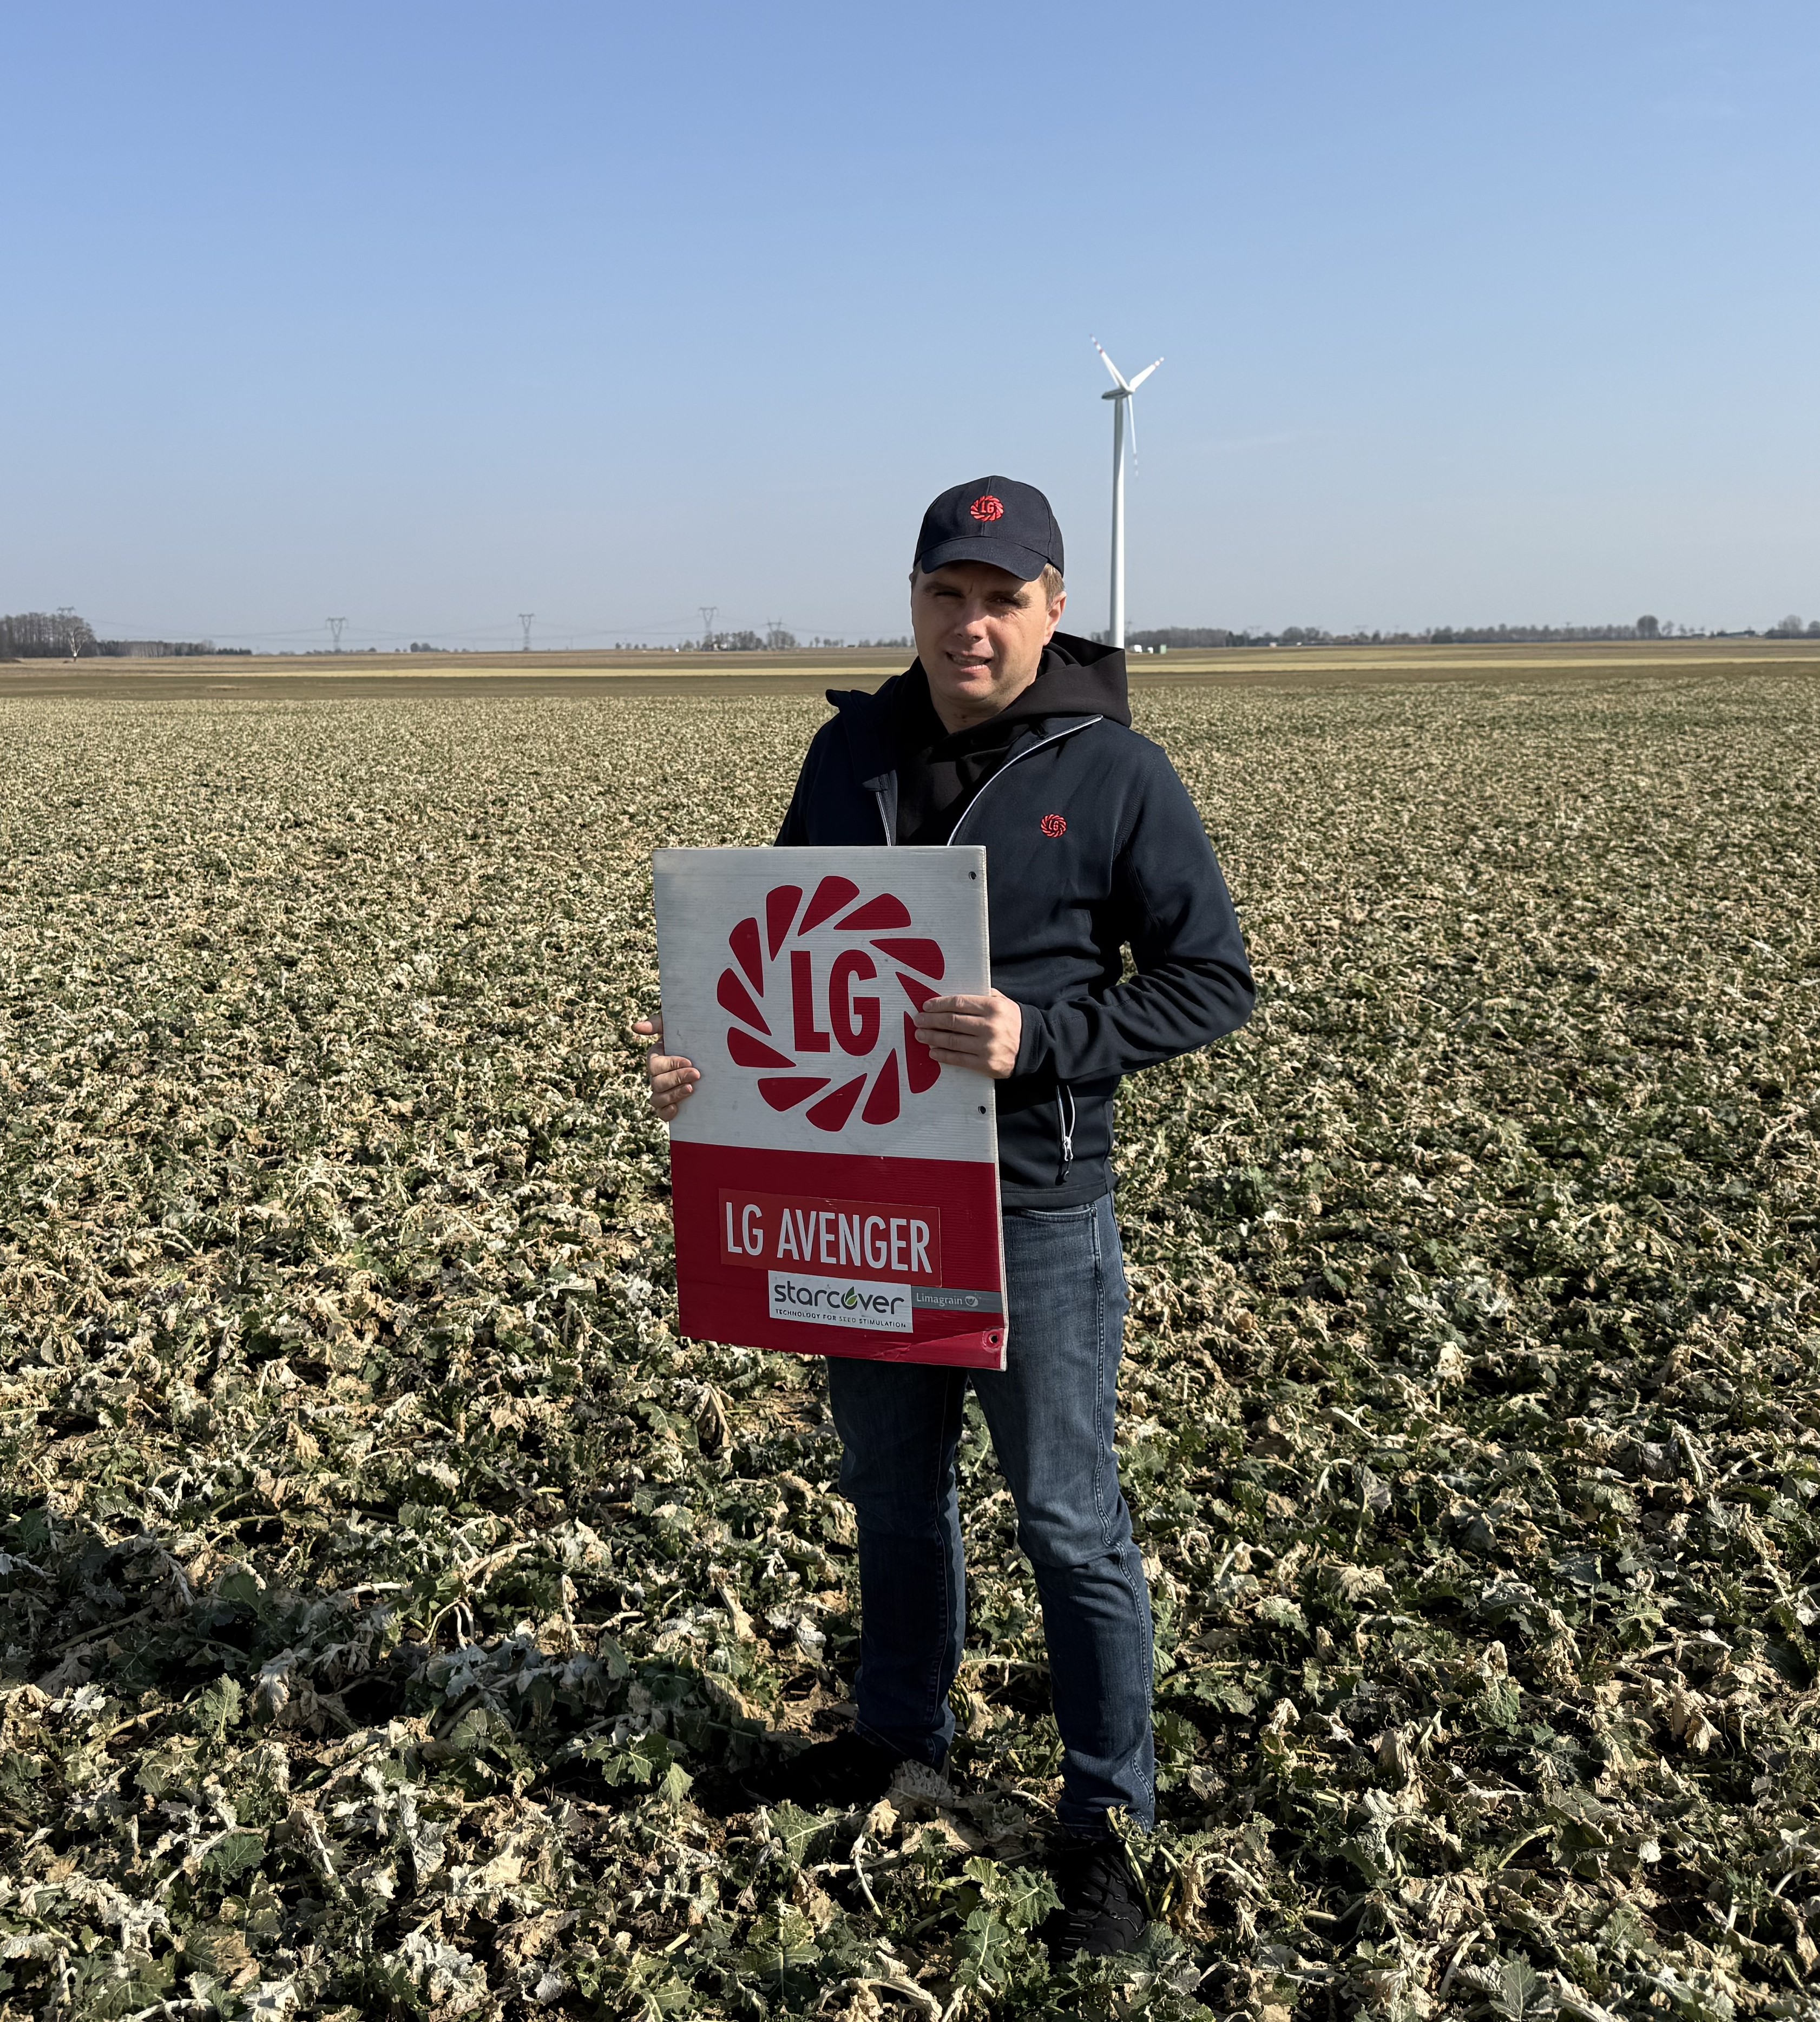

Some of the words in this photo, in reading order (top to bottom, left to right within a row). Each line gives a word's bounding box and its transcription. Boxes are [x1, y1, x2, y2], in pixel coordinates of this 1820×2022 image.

[981, 500, 995, 513] LG
[790, 949, 881, 1056] LG
[726, 1202, 764, 1256] LG
[777, 1208, 932, 1273] AVENGER
[774, 1280, 904, 1315] starcover
[916, 1292, 963, 1307] Limagrain
[776, 1308, 820, 1319] TECHNOLOGY
[859, 1318, 906, 1328] STIMULATION
